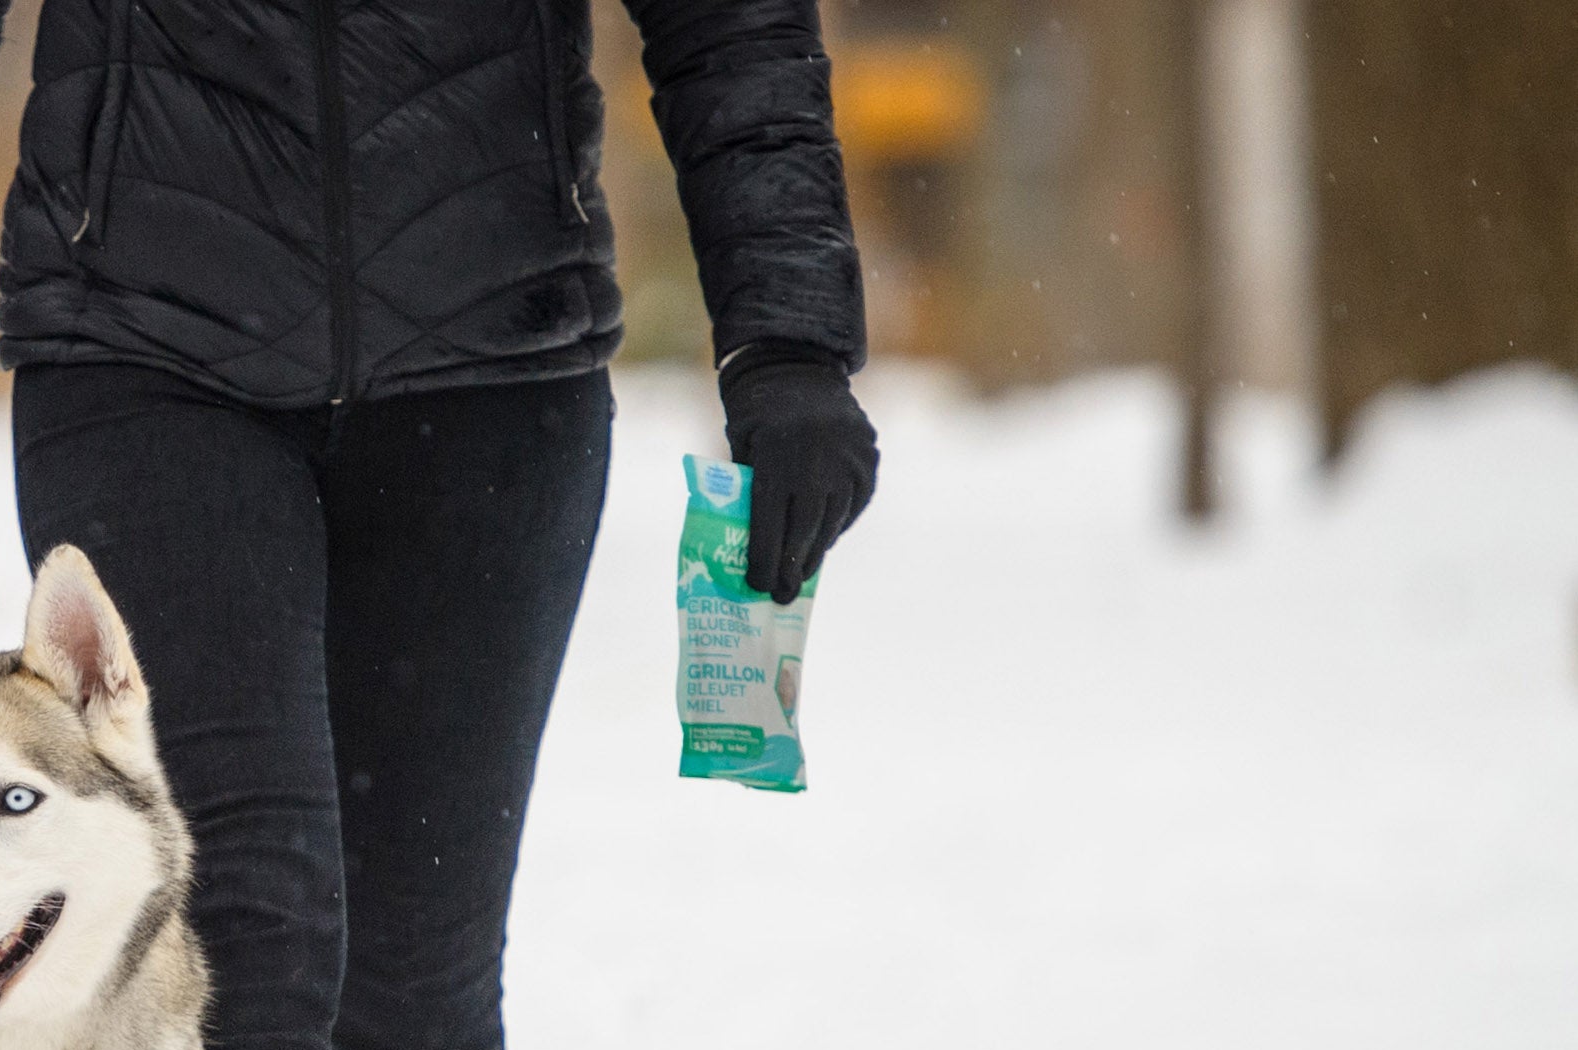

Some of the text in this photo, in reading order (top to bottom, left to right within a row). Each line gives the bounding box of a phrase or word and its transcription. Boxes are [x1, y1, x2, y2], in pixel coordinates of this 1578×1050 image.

[687, 633, 741, 648] HONEY
[687, 664, 766, 683] GRILLON
[687, 682, 746, 697] BLEUET
[687, 700, 725, 713] MIEL
